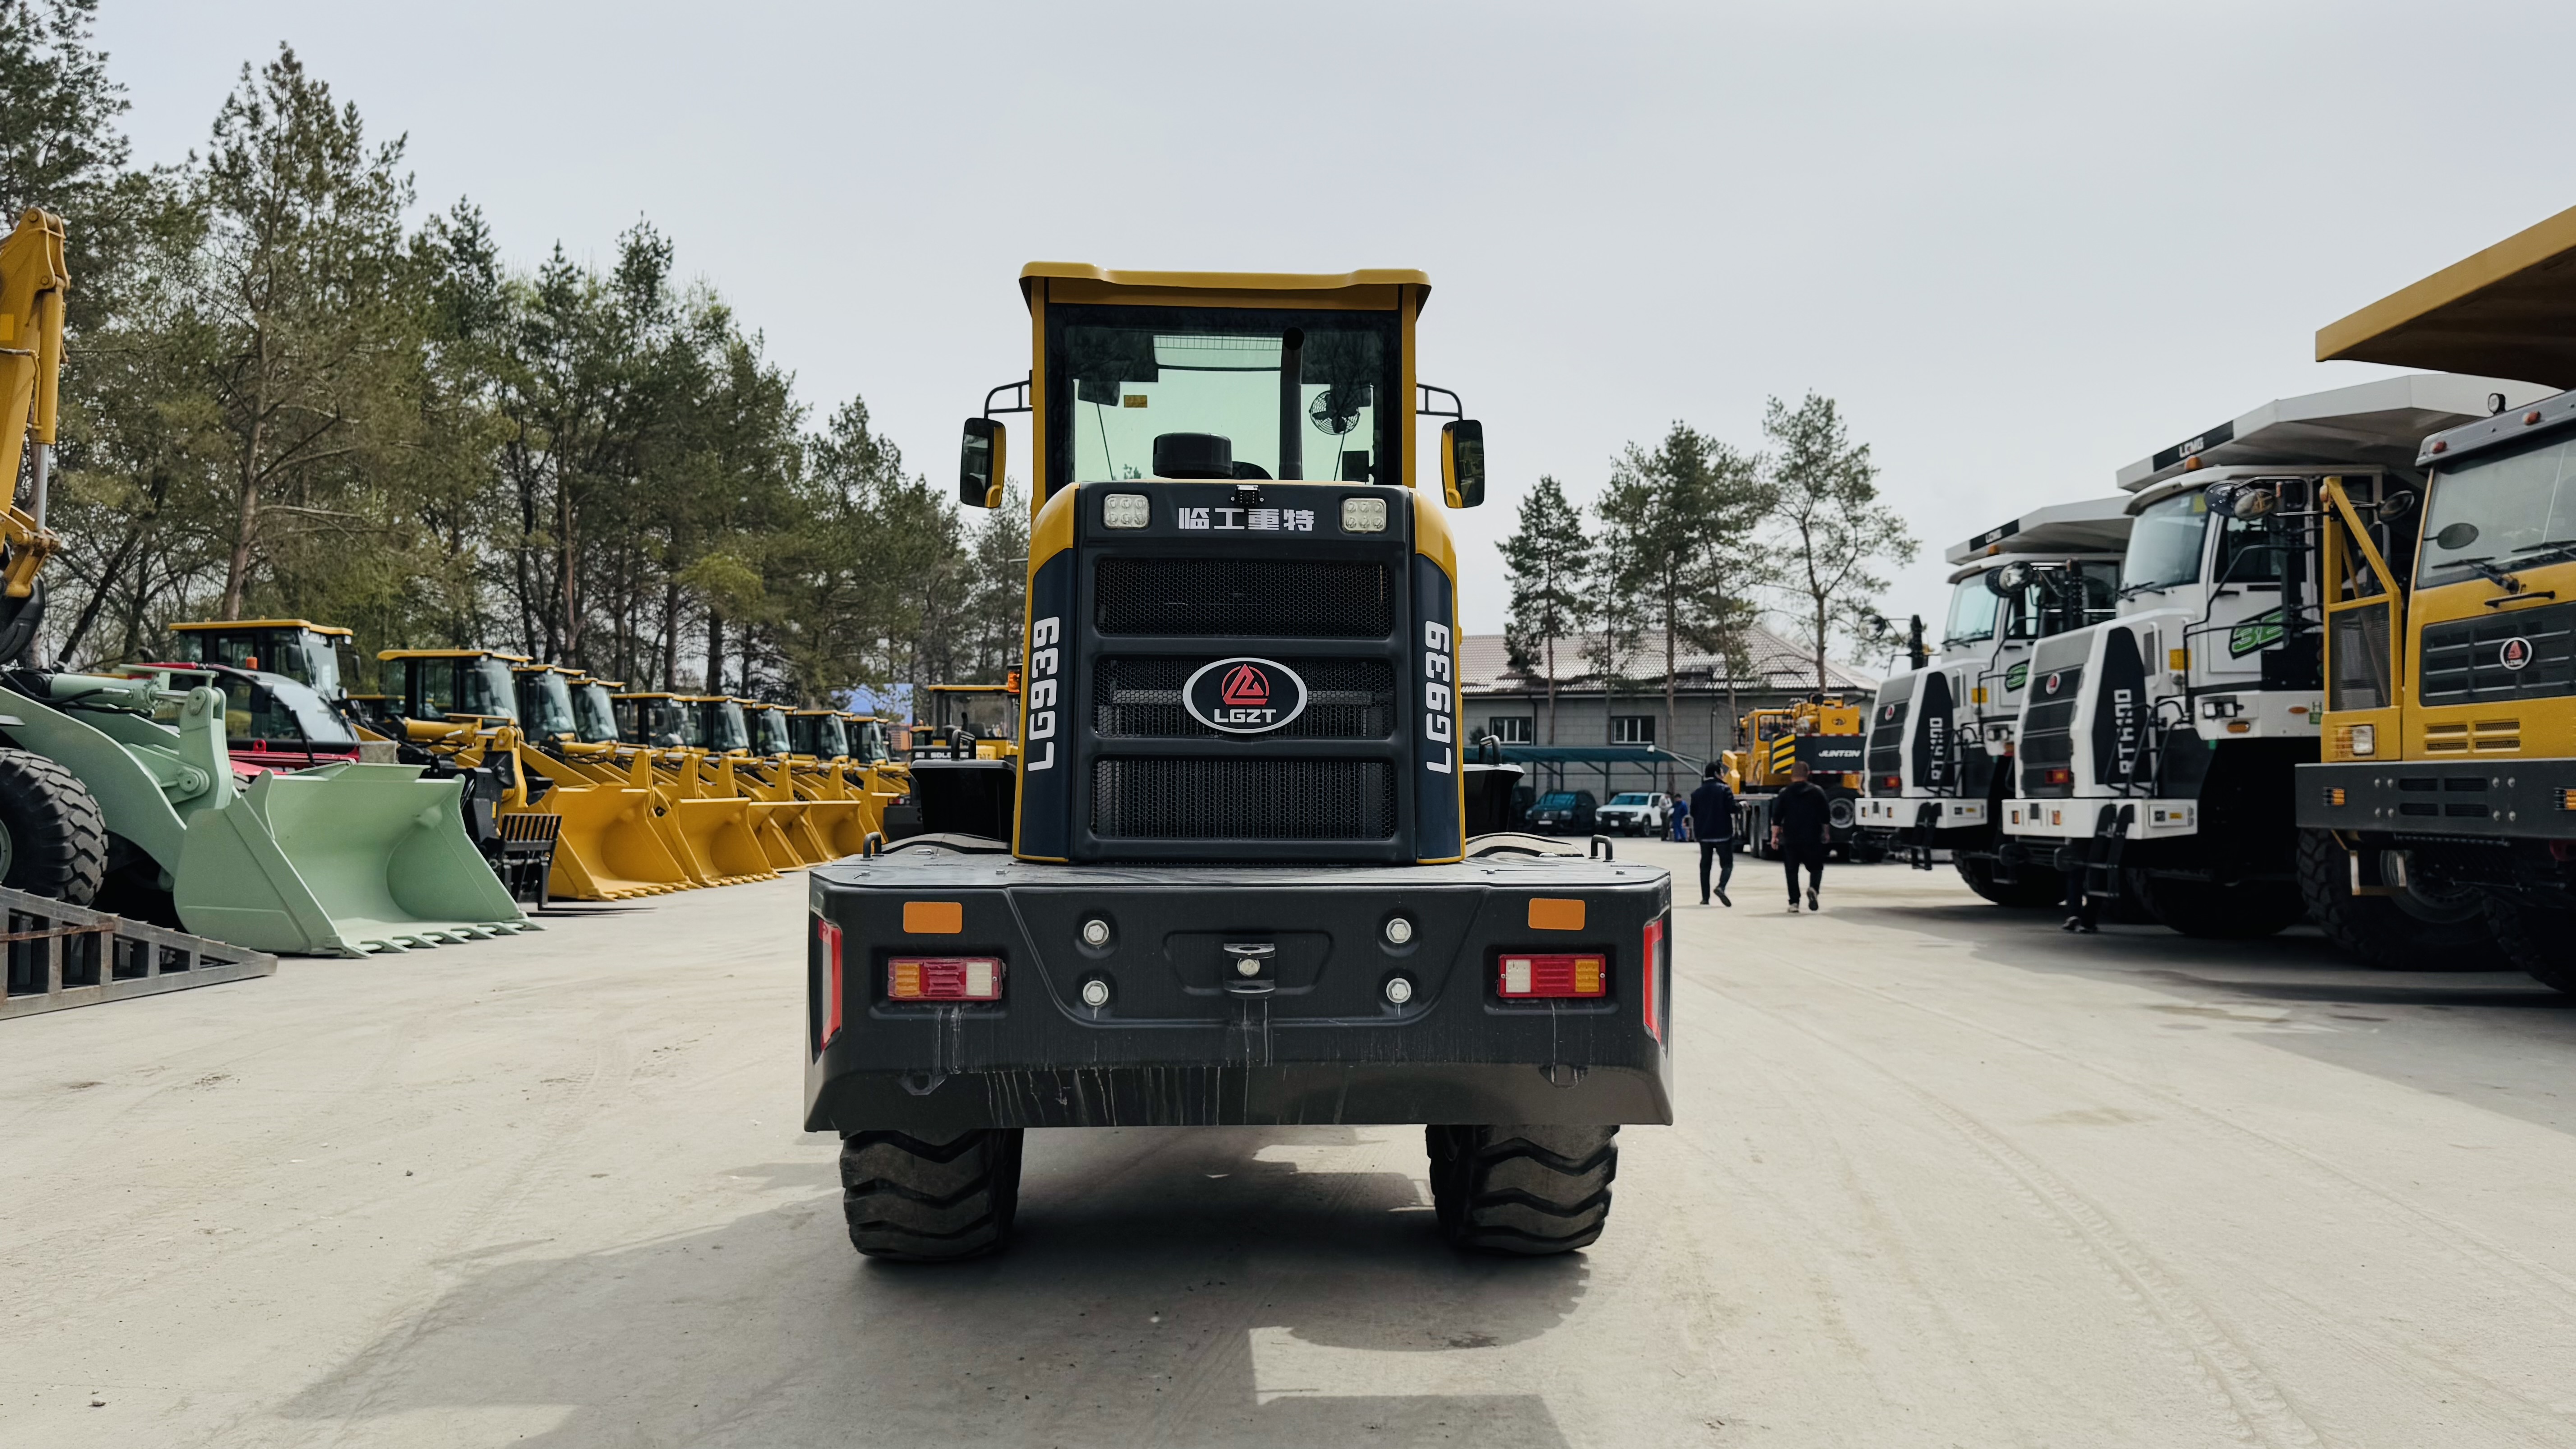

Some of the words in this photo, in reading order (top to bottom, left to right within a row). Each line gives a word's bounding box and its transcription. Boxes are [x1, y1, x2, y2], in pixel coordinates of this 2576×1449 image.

[1178, 508, 1314, 531] 临工重特
[1028, 616, 1059, 771] LG939
[1214, 709, 1276, 723] LGZT
[1425, 621, 1451, 774] LG939
